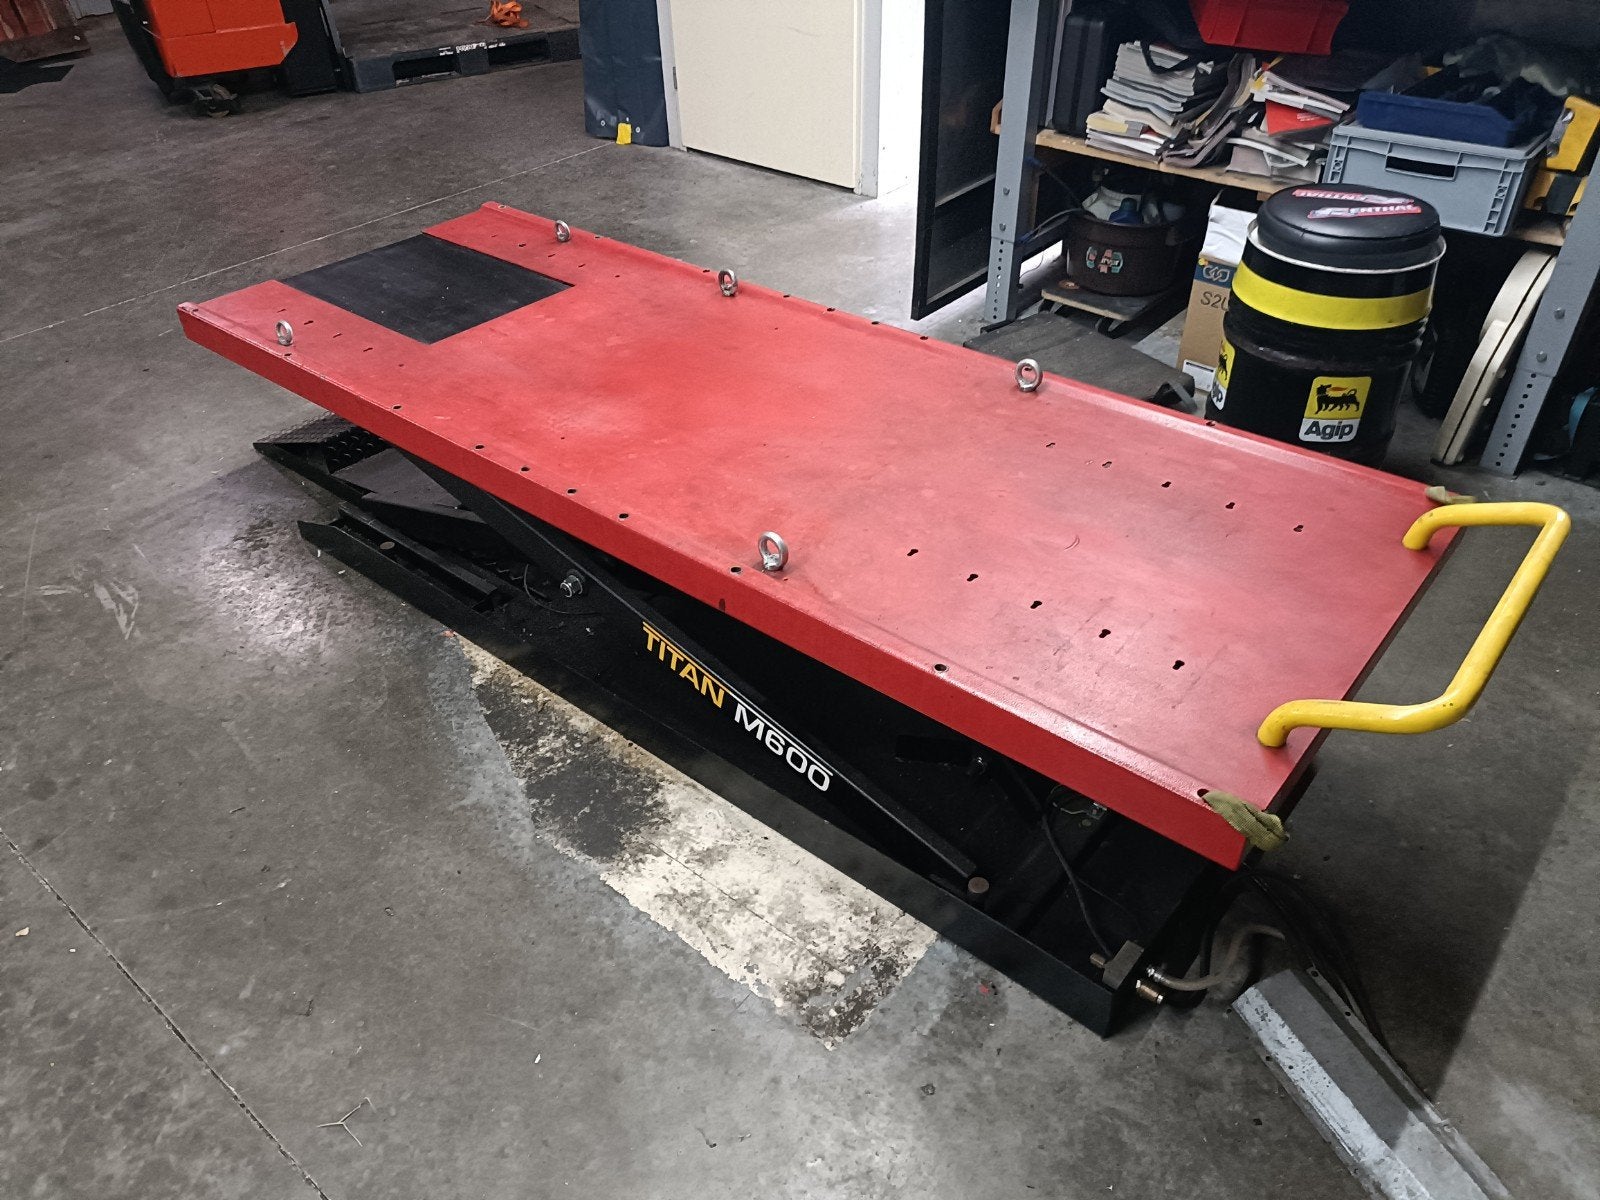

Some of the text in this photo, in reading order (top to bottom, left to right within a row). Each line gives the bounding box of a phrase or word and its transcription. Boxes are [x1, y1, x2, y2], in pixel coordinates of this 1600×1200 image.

[1304, 420, 1354, 440] Agip
[642, 624, 832, 792] TITAN M600
